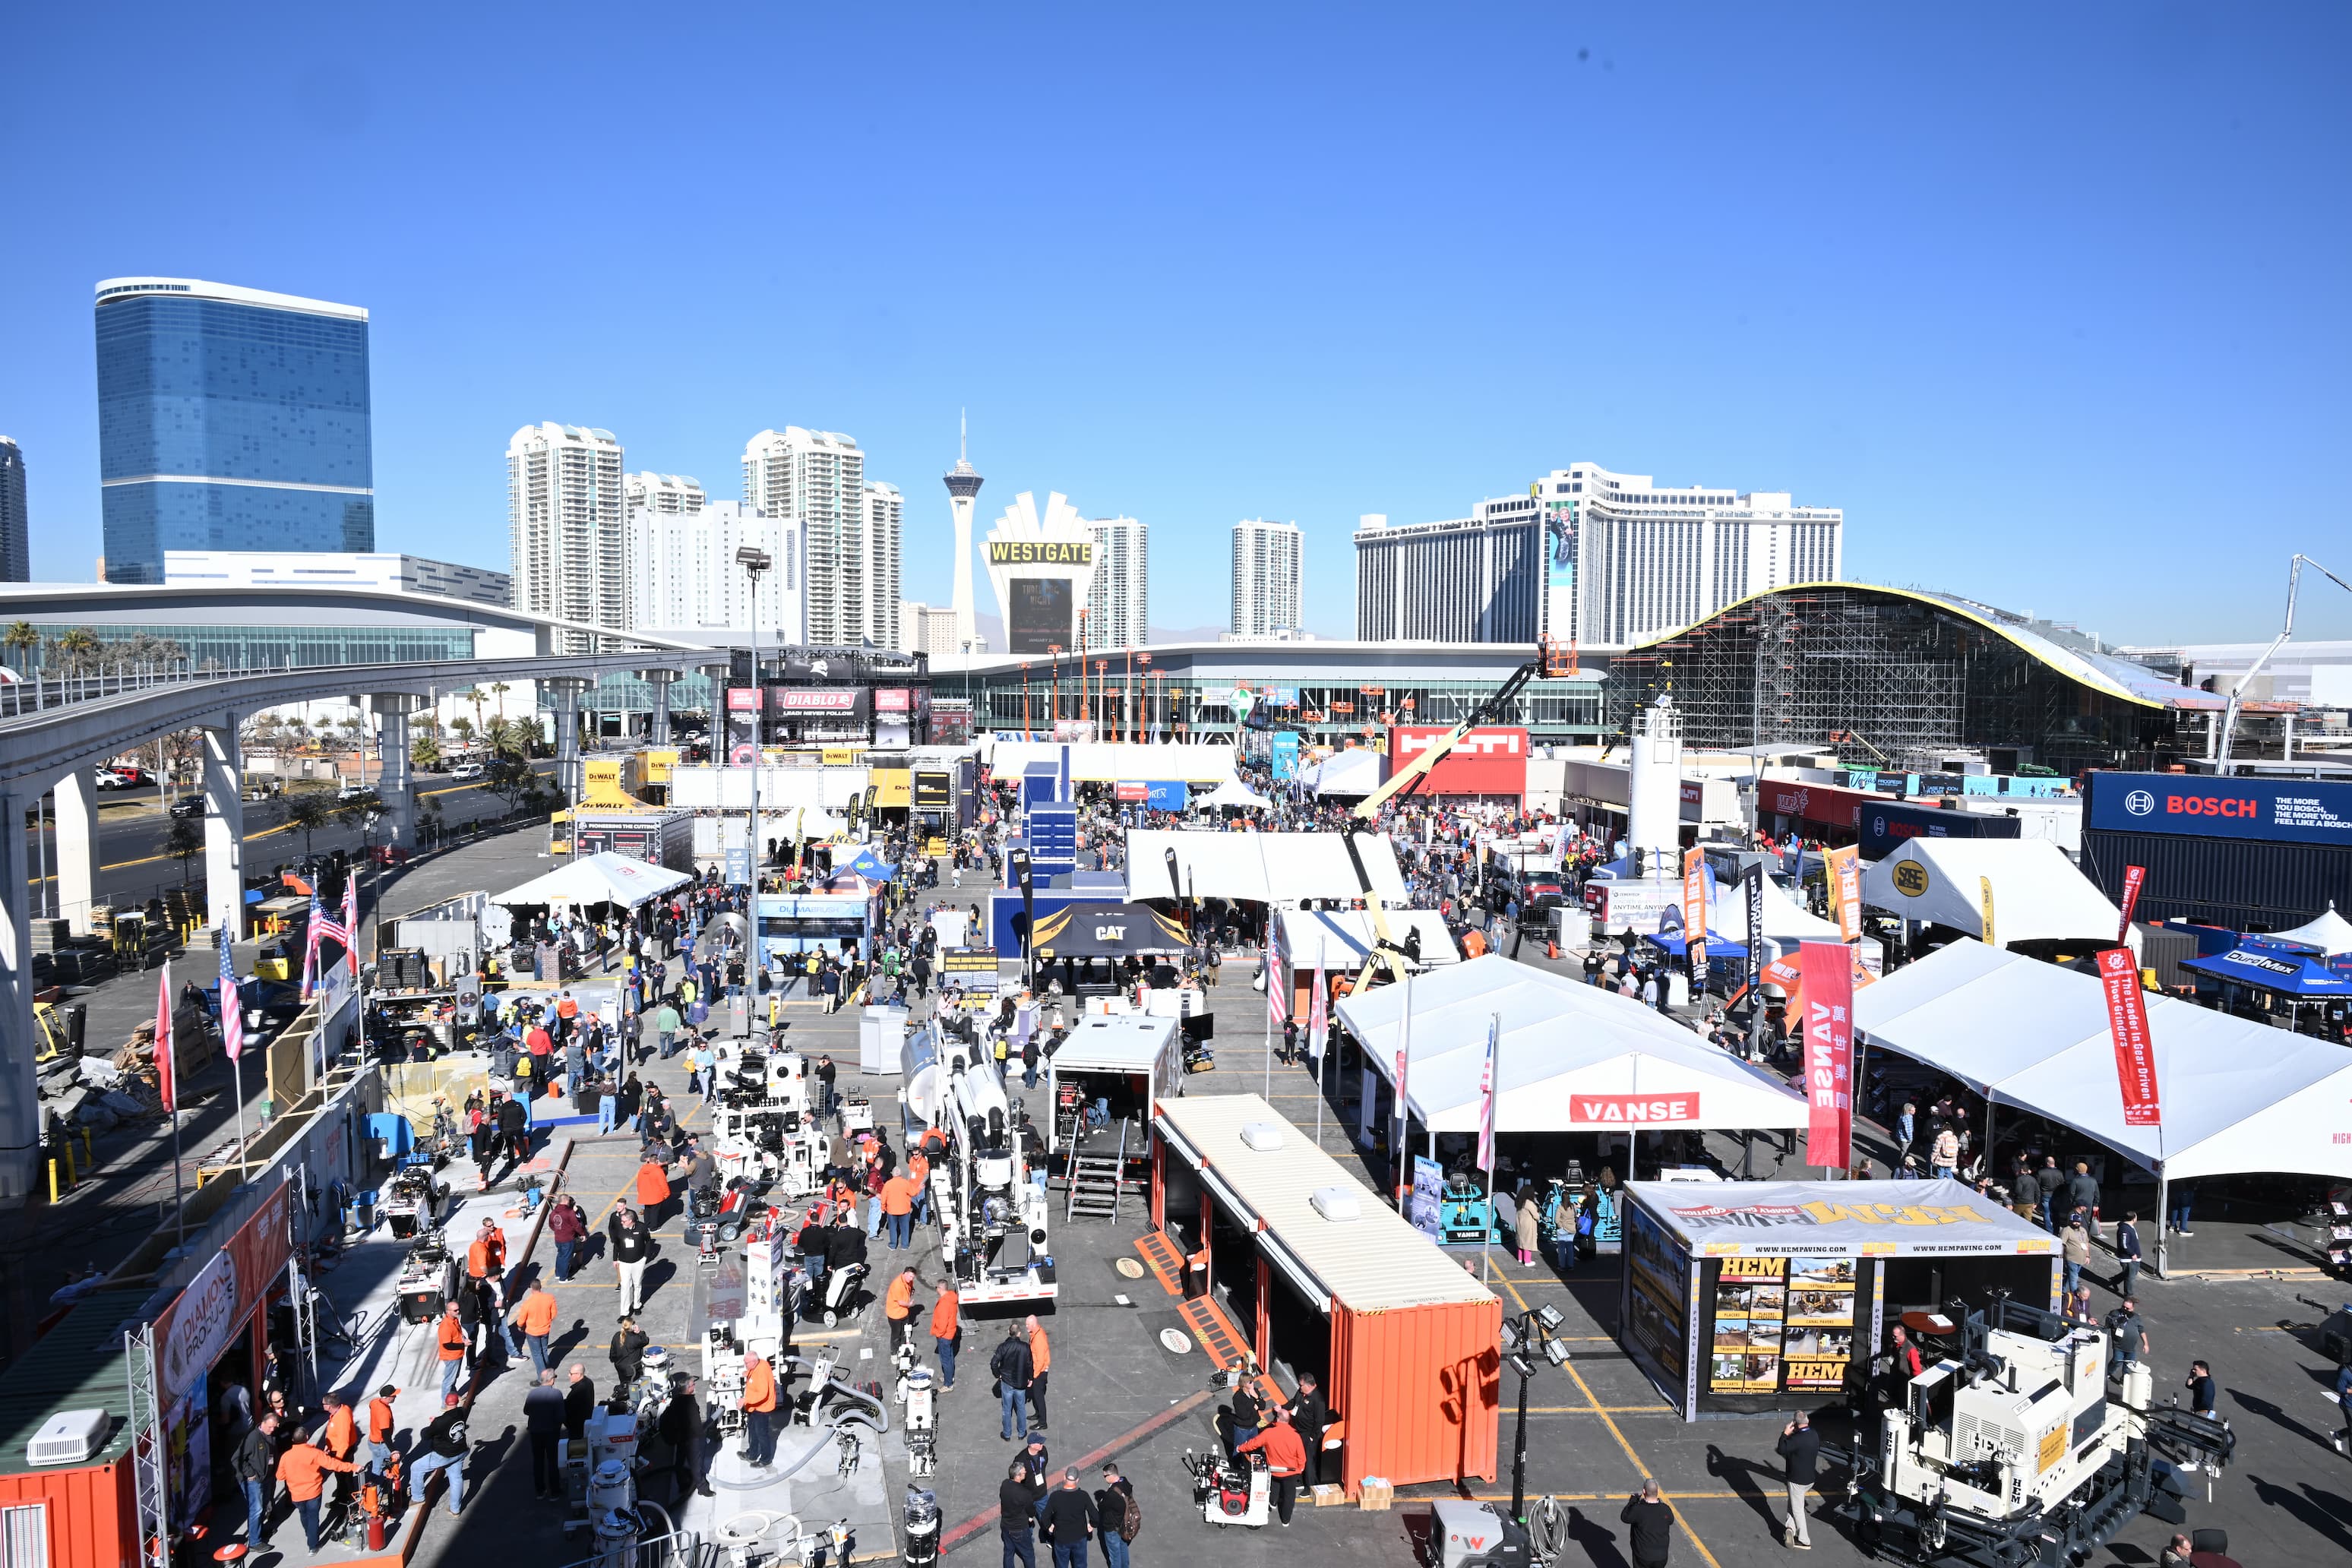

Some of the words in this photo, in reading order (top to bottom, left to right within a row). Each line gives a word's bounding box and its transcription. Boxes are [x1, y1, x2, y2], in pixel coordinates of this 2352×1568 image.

[991, 542, 1092, 561] WESTGATE
[1029, 595, 1051, 605] NIGHT
[788, 694, 837, 706] DIABLO
[1401, 735, 1519, 753] HLTI
[2167, 795, 2256, 818] BOSCH
[2292, 811, 2319, 820] MORE
[2294, 805, 2327, 814] BOSCH,
[1889, 823, 1923, 838] BOSCH
[2296, 818, 2316, 827] LIKE
[1013, 852, 1026, 863] CAT
[1165, 851, 1174, 862] CAT
[733, 872, 741, 881] 2
[1021, 871, 1029, 884] CAT
[1898, 866, 1924, 887] SASE
[1687, 872, 1701, 901] HEN
[1841, 871, 1858, 902] HEN
[2123, 885, 2132, 904] Floor
[1686, 902, 1702, 937] MUD
[1844, 902, 1860, 936] MUD
[2119, 903, 2129, 932] Grinders
[1095, 925, 1127, 941] CAT
[1691, 942, 1707, 965] #1
[2122, 977, 2132, 996] The
[2222, 974, 2241, 984] Power
[2109, 979, 2120, 1004] Floor
[2124, 997, 2139, 1031] Leader
[2113, 1004, 2128, 1048] Grinders
[2131, 1032, 2142, 1042] In
[2133, 1043, 2145, 1067] Gear
[2137, 1067, 2151, 1099] Driven
[1582, 1101, 1687, 1121] VANSE
[2332, 1133, 2351, 1144] HIGH
[1420, 1159, 1435, 1168] VANSE
[1674, 1206, 1727, 1216] SOLUTIONS
[1678, 1212, 1818, 1228] PAVING
[1799, 1200, 1994, 1225] HEM
[1705, 1242, 1740, 1253] HEM
[1862, 1242, 1896, 1253] HEM
[2017, 1240, 2050, 1250] HEM
[1720, 1257, 1786, 1276] HEM
[1873, 1276, 1883, 1301] HEM
[1786, 1363, 1846, 1380] HEM
[1885, 1430, 1893, 1456] HEM
[2011, 1478, 2022, 1505] HEM
